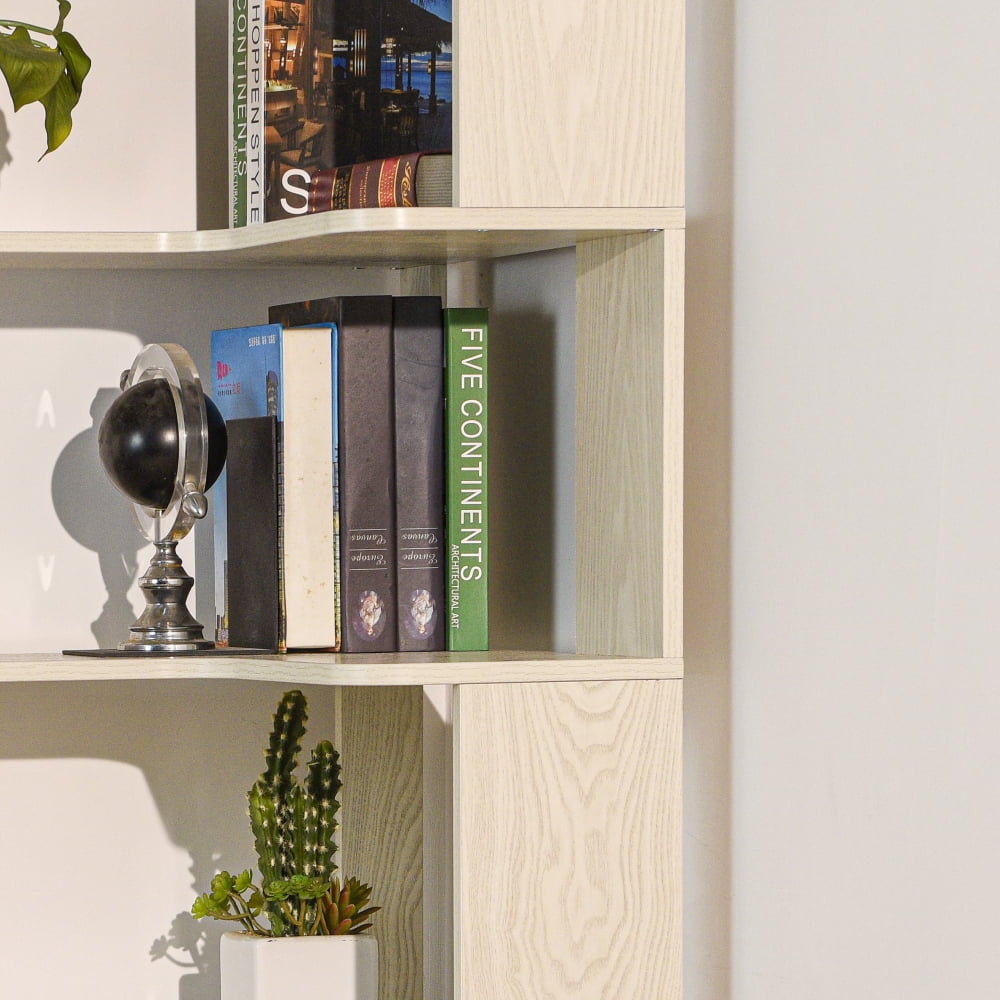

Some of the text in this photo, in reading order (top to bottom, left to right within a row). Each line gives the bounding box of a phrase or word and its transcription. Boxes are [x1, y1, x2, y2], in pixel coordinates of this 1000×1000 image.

[251, 5, 260, 224] HOPPEN STYLE
[460, 328, 483, 581] FIVE CONTINENTS
[351, 533, 387, 545] Canvas
[402, 533, 438, 544] Canvas
[451, 544, 460, 628] ARCHITECTURAL ART
